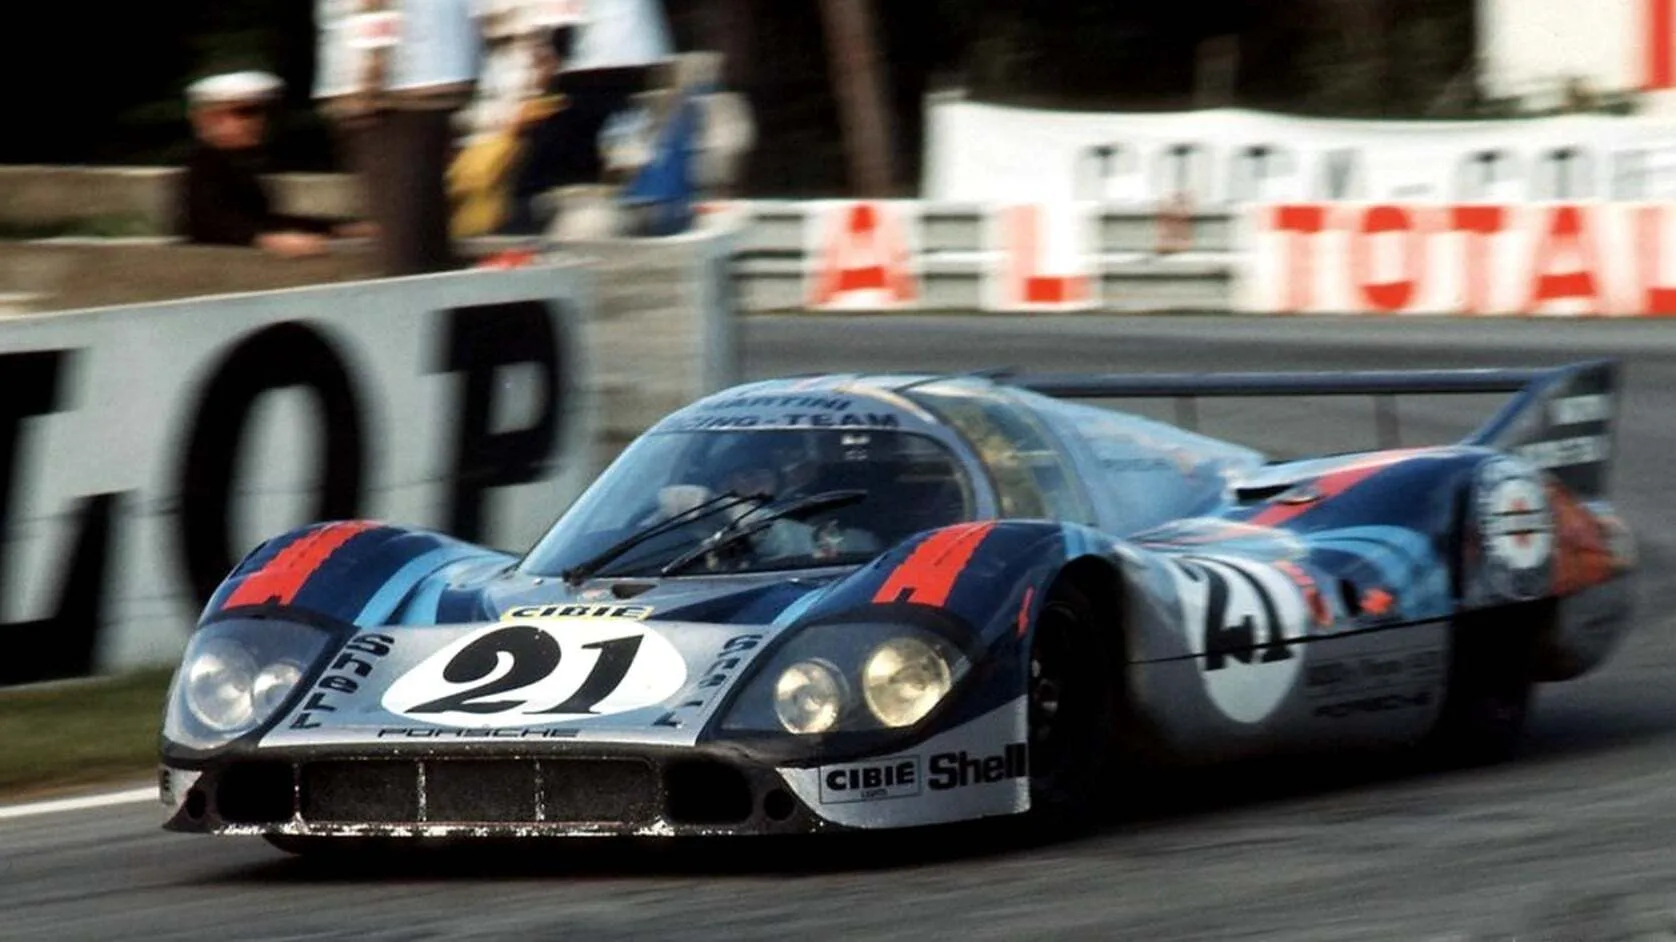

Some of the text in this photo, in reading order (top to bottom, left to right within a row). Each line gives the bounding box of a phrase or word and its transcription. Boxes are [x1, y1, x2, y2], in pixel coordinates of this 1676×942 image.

[1258, 204, 1676, 313] TOTAL
[1174, 556, 1295, 672] 21
[404, 625, 645, 715] 21
[377, 727, 580, 738] PORSCHE
[826, 743, 1026, 791] CIBIE Shell
